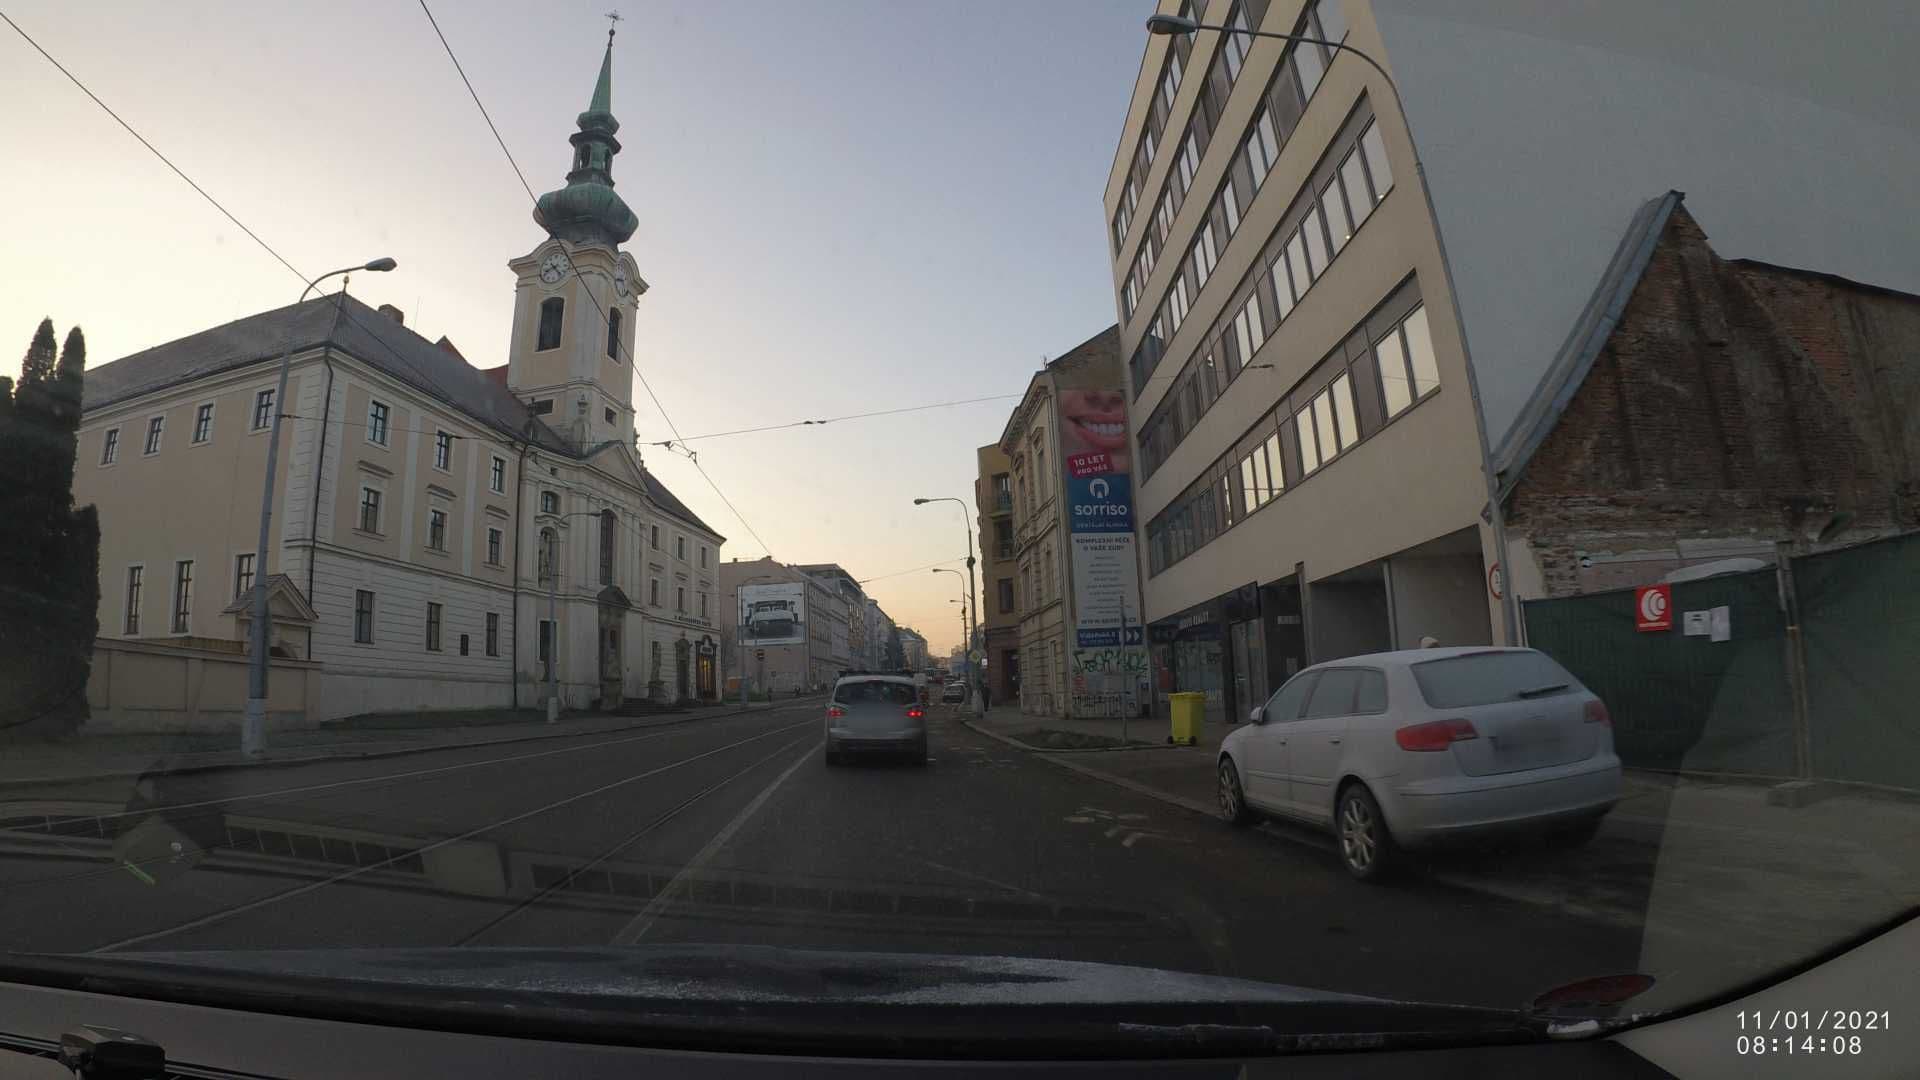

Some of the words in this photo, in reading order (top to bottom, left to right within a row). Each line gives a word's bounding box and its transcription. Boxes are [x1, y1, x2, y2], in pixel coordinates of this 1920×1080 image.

[1073, 458, 1085, 467] 10
[1088, 454, 1105, 464] LET
[1074, 501, 1127, 516] sorriso
